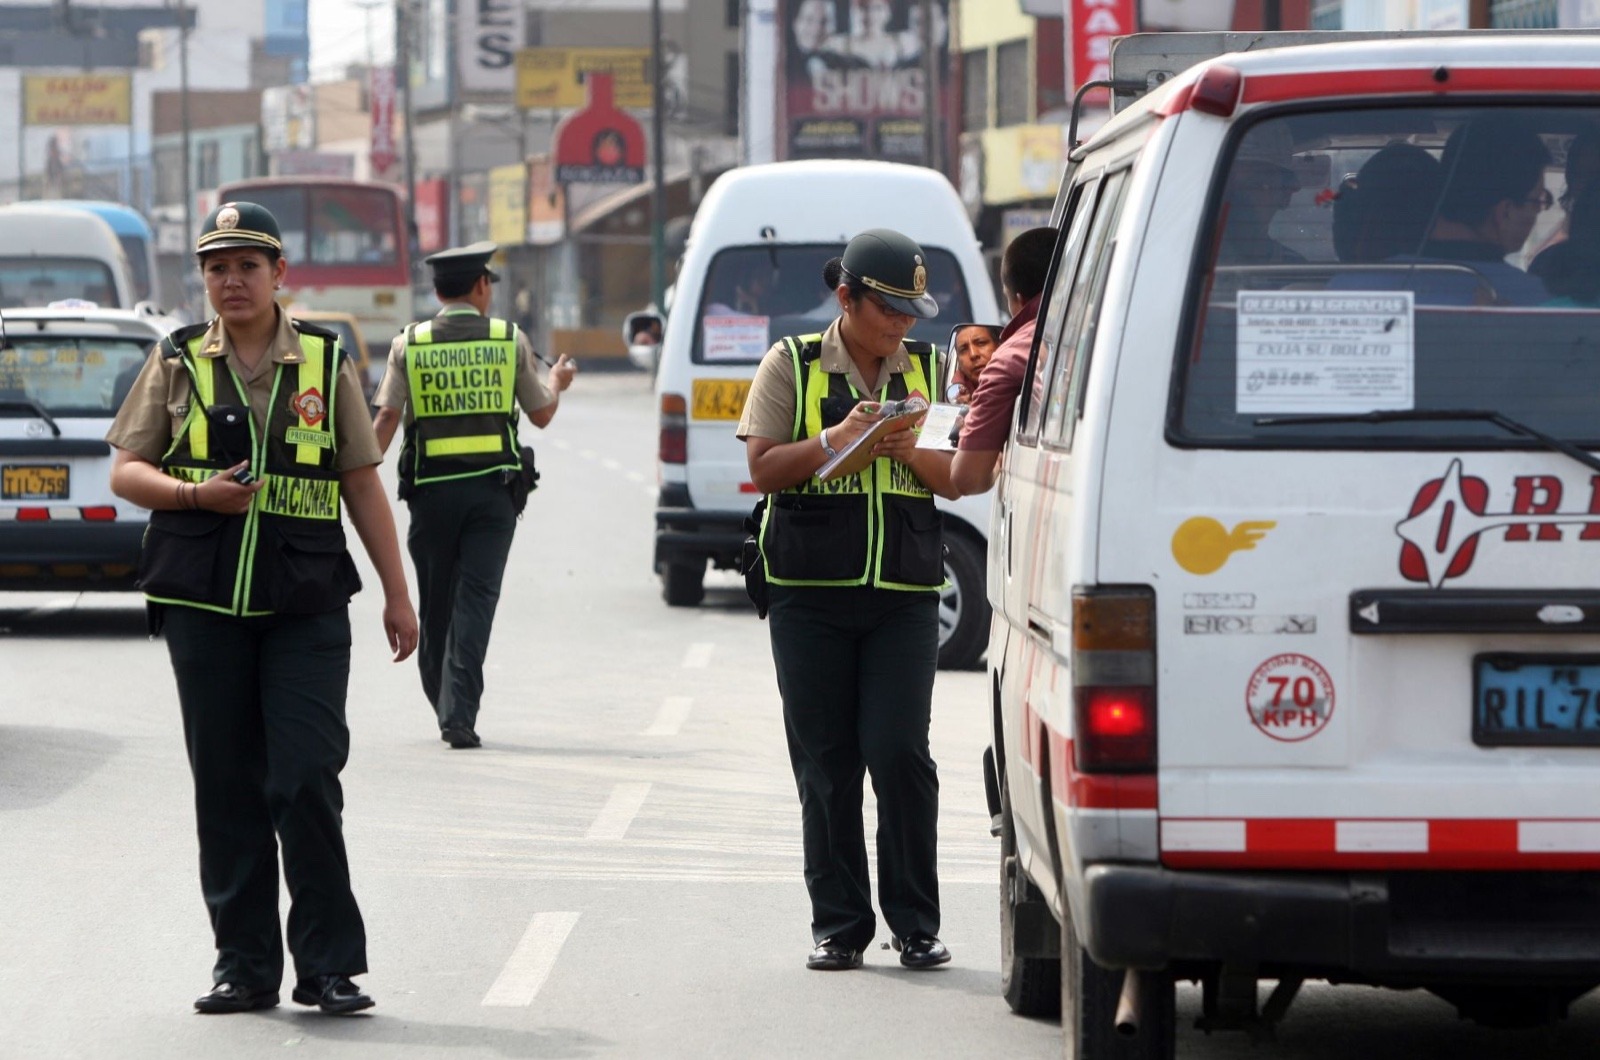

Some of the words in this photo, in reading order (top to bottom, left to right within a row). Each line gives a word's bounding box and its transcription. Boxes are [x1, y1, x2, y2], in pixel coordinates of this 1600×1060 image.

[811, 68, 926, 112] SHOWS
[415, 347, 507, 370] ALCOHOLEMIA
[420, 368, 503, 391] POLICIA
[420, 391, 504, 413] TRANSITO
[290, 430, 328, 444] PREVENCION
[264, 474, 334, 516] NACIONAL
[1267, 675, 1316, 708] 70
[1262, 709, 1318, 728] KPH
[1485, 687, 1600, 729] RIL-7
